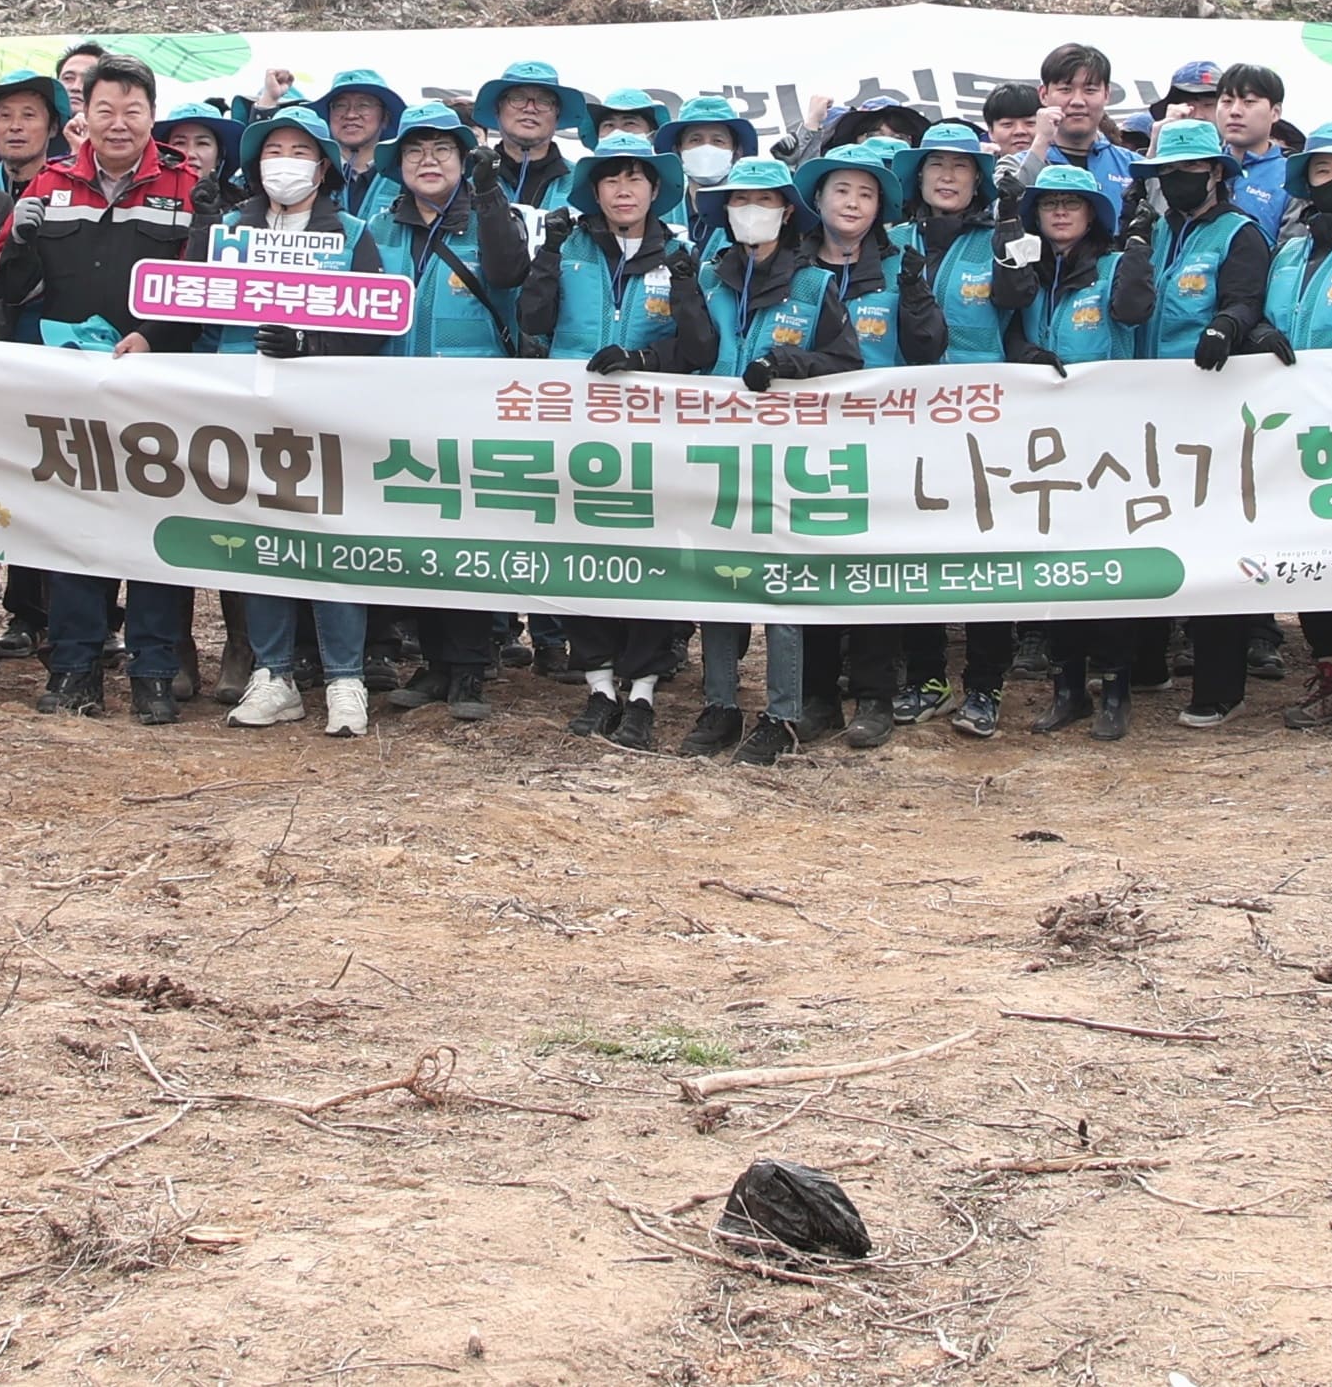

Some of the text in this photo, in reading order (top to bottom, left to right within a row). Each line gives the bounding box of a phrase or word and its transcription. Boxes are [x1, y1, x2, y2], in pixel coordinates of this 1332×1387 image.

[254, 249, 315, 266] STEEL
[255, 232, 340, 250] HYUNDAI
[142, 273, 402, 321] 마중물 주부봉사단
[495, 379, 1004, 426] 숲을 통한 탄소중립 녹색 성장
[24, 413, 344, 516] 제80회
[373, 438, 655, 528] 식목일
[686, 442, 870, 536] 기념
[914, 420, 1258, 536] 나무심기
[254, 535, 307, 569] 일시
[332, 545, 411, 573] 2025.
[420, 549, 448, 577] 3.
[455, 550, 550, 585] 25.(화)
[762, 562, 820, 594] 장소
[845, 562, 930, 594] 정미면
[938, 561, 1024, 593] 도산리
[1033, 559, 1123, 588] 385-9
